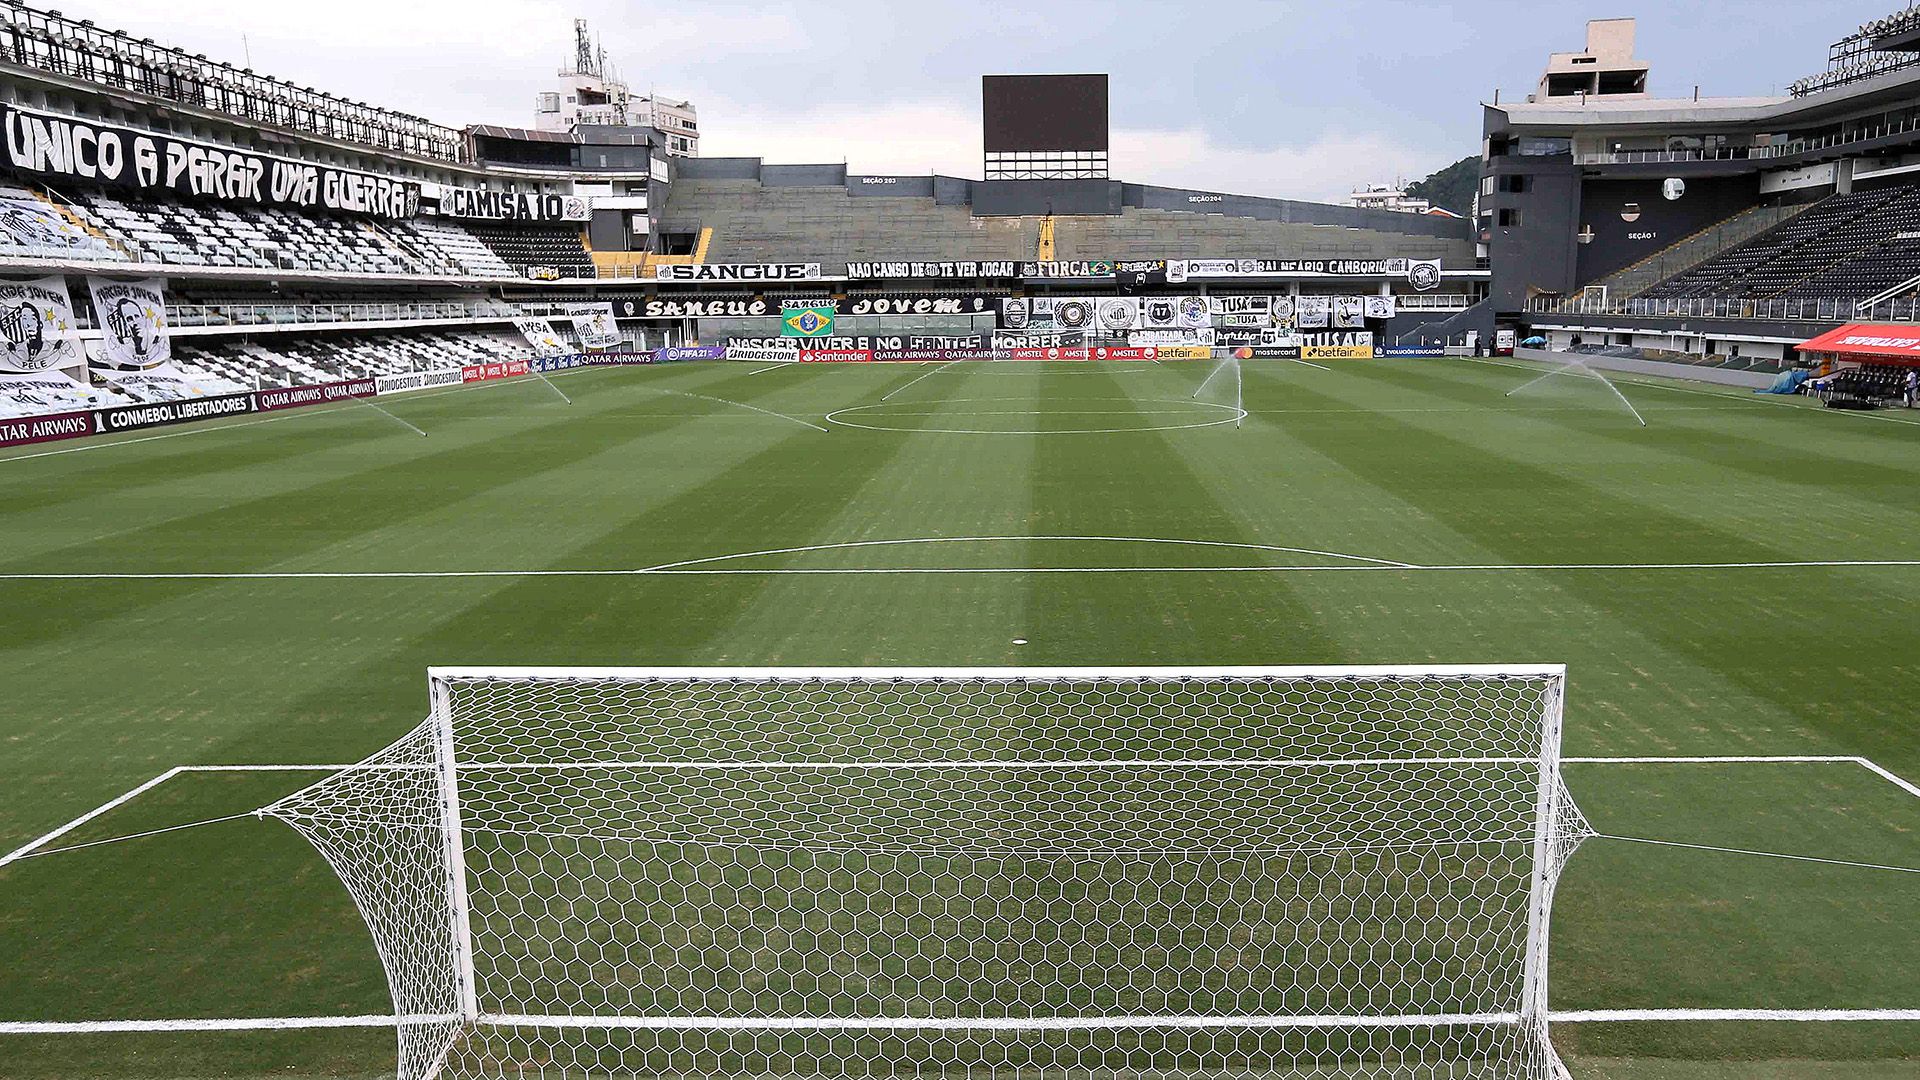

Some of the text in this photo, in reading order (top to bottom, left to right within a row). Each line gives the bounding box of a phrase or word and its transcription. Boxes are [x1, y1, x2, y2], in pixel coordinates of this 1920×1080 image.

[134, 136, 158, 187] A
[165, 142, 263, 203] PARAR
[271, 161, 318, 207] UMA
[324, 170, 405, 219] GUERRA
[454, 189, 564, 222] CAMISA 10
[673, 264, 805, 280] SANGUE
[872, 262, 909, 278] CANSO
[911, 262, 924, 278] DE
[940, 262, 954, 277] TE
[955, 261, 977, 277] VER
[979, 261, 1014, 277] JOGAR
[1221, 297, 1248, 312] TUSA
[1340, 297, 1358, 306] TUSA
[1155, 307, 1167, 316] 17
[1236, 315, 1258, 324] TUSA
[728, 337, 797, 350] NASCER
[799, 337, 855, 350] VIVER
[876, 337, 902, 350] NO
[1303, 332, 1355, 347] TUSA
[581, 354, 612, 364] QATAR
[729, 350, 797, 361] BRIDGESTONE
[814, 351, 868, 361] Santander
[874, 350, 940, 359] QATAR AIRWAYS
[945, 351, 973, 360] QATAR
[464, 371, 478, 379] AMSTEL
[487, 367, 501, 376] AMSTEL
[509, 364, 522, 373] AMSTEL
[378, 375, 422, 392] BRIDGESTONE
[424, 371, 462, 386] BRIDGESTONE
[324, 382, 375, 399] QATAR AIRWAYS
[262, 388, 322, 408] QATAR AIRWAYS
[110, 397, 247, 428] CONMEBOL LIBERTADORES
[32, 416, 87, 437] AIRWAYS
